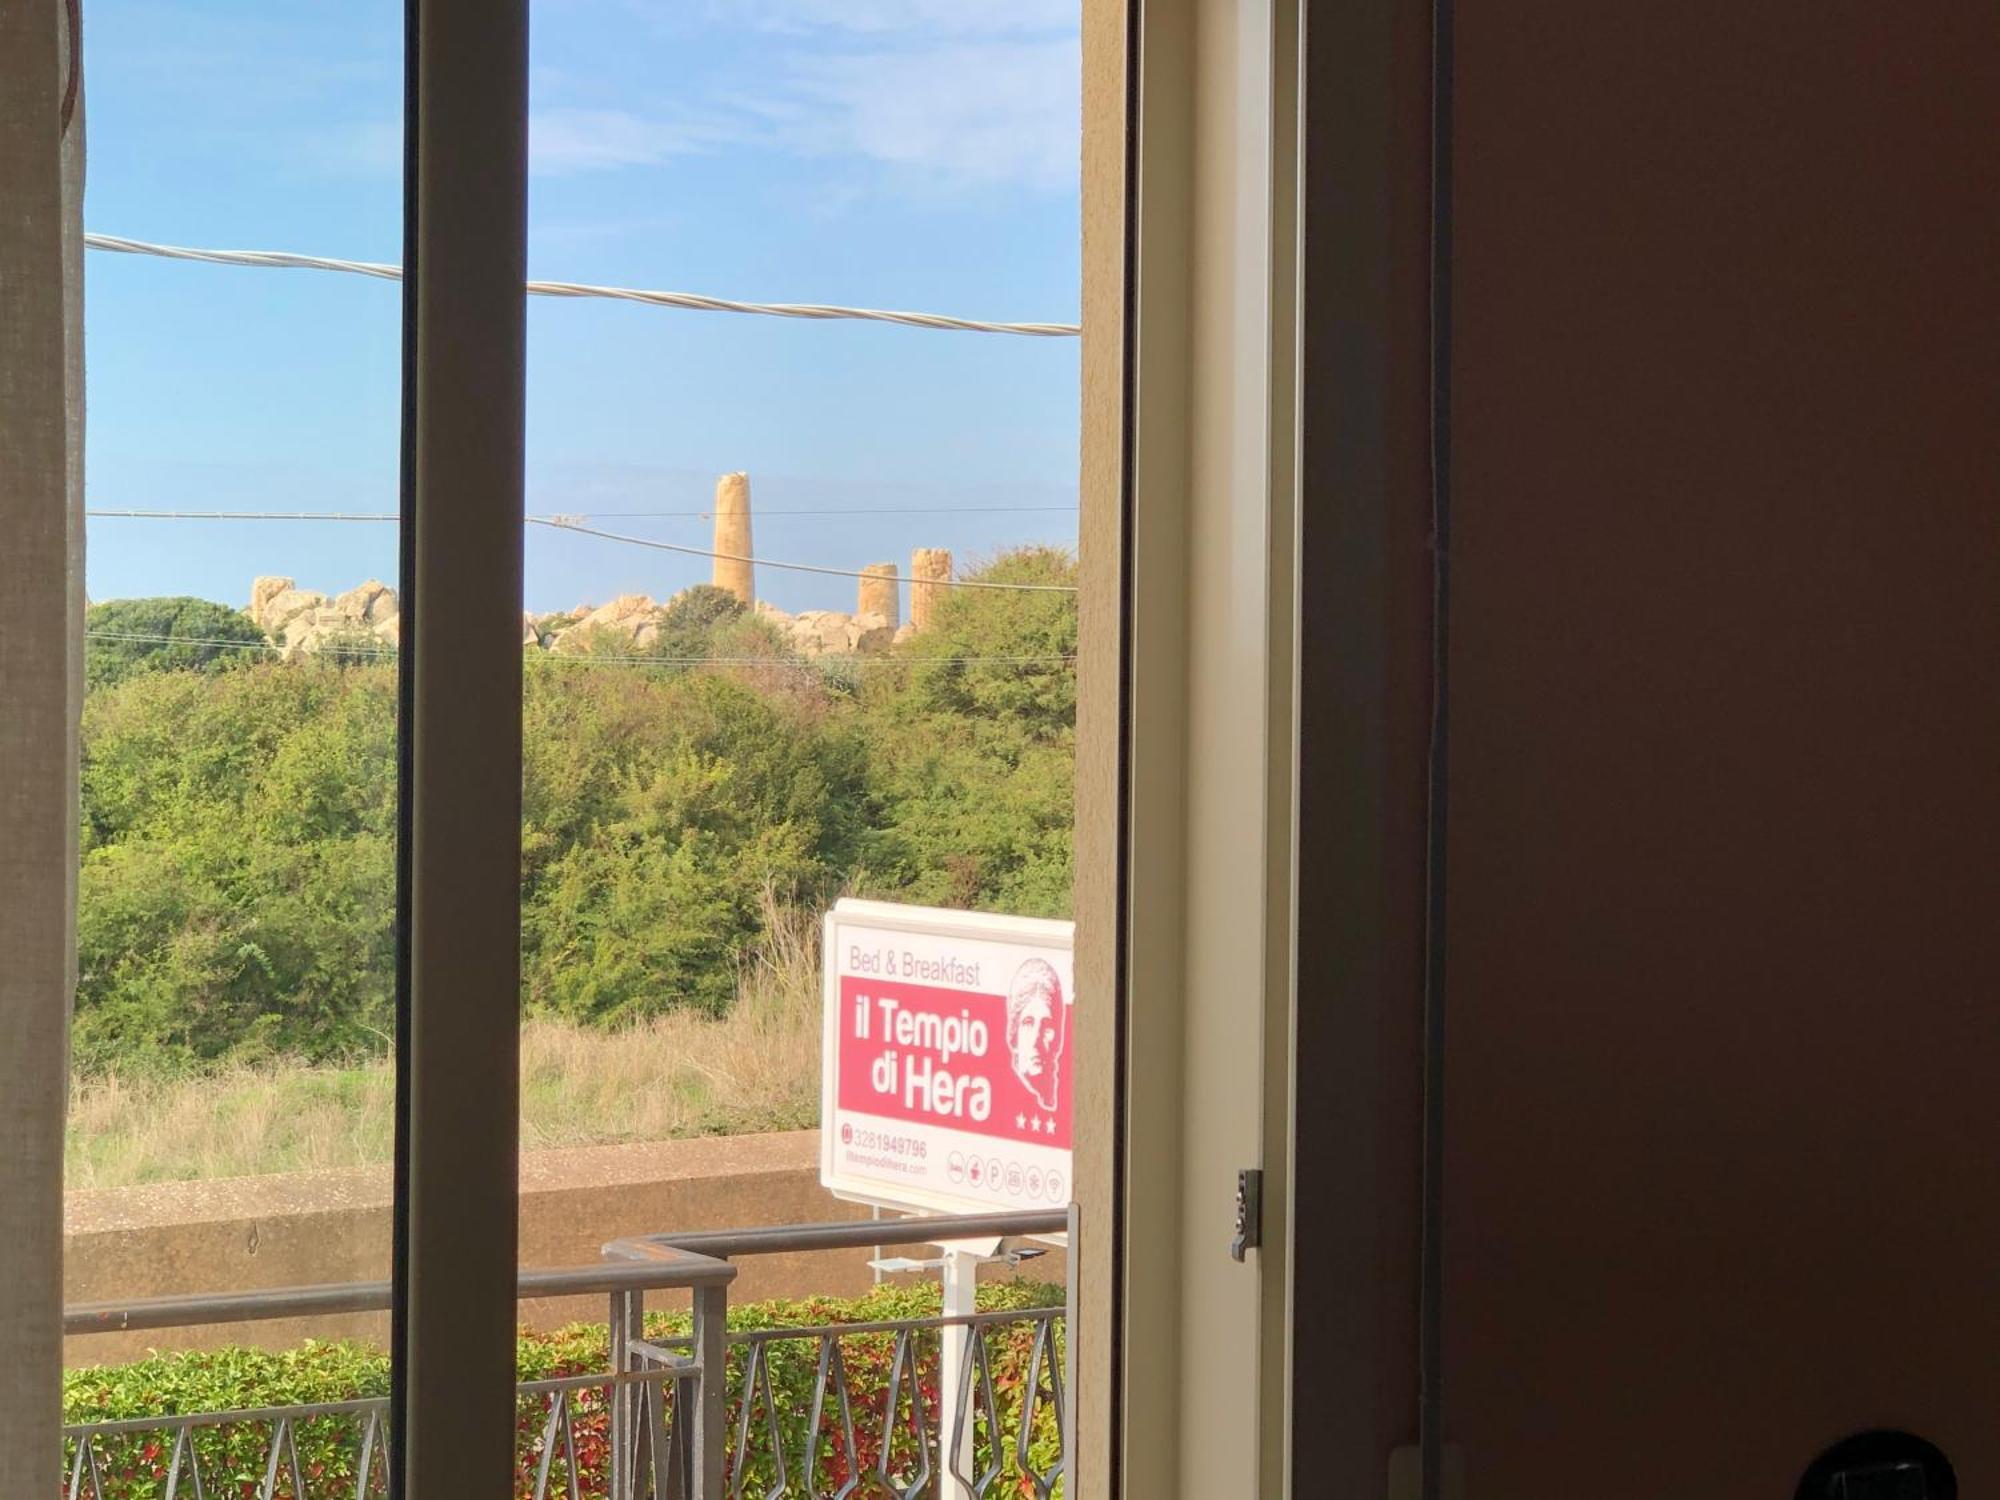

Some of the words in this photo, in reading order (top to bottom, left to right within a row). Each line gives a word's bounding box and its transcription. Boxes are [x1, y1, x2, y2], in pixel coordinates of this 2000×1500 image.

[850, 945, 880, 974] Bed
[886, 950, 897, 976] &
[902, 951, 981, 986] Breakfast
[855, 995, 870, 1039] il
[878, 999, 988, 1063] Tempio
[872, 1050, 898, 1094] di
[904, 1054, 992, 1121] Hera
